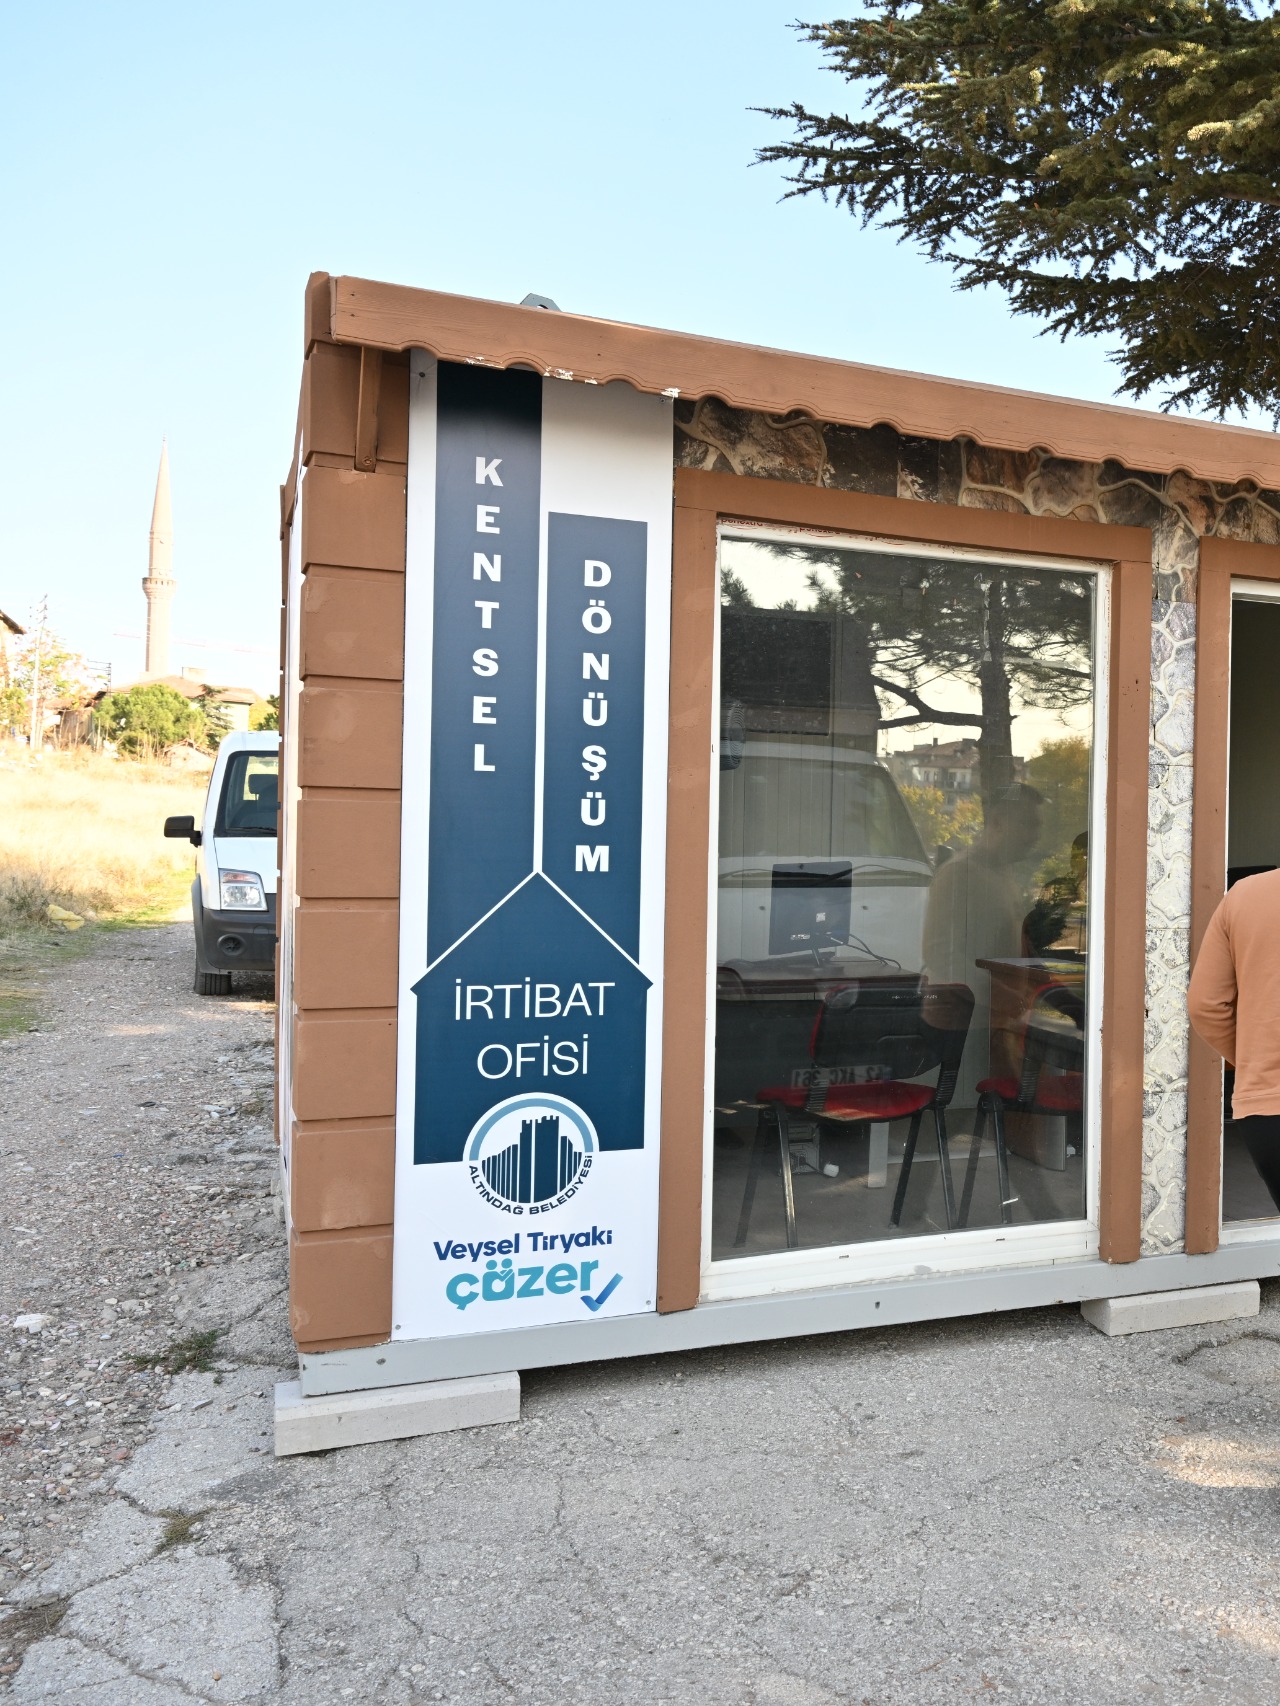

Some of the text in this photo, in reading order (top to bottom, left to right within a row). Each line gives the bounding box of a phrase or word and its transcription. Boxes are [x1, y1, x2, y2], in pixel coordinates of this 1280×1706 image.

[472, 456, 504, 772] KENTSEL
[575, 559, 612, 873] DÖNÜŞÜM
[455, 976, 616, 1021] İRTİBAT
[477, 1034, 589, 1080] OFİSİ
[469, 1155, 593, 1215] ALTINDAĞ BELEDİYESİ
[433, 1233, 520, 1262] Veysel
